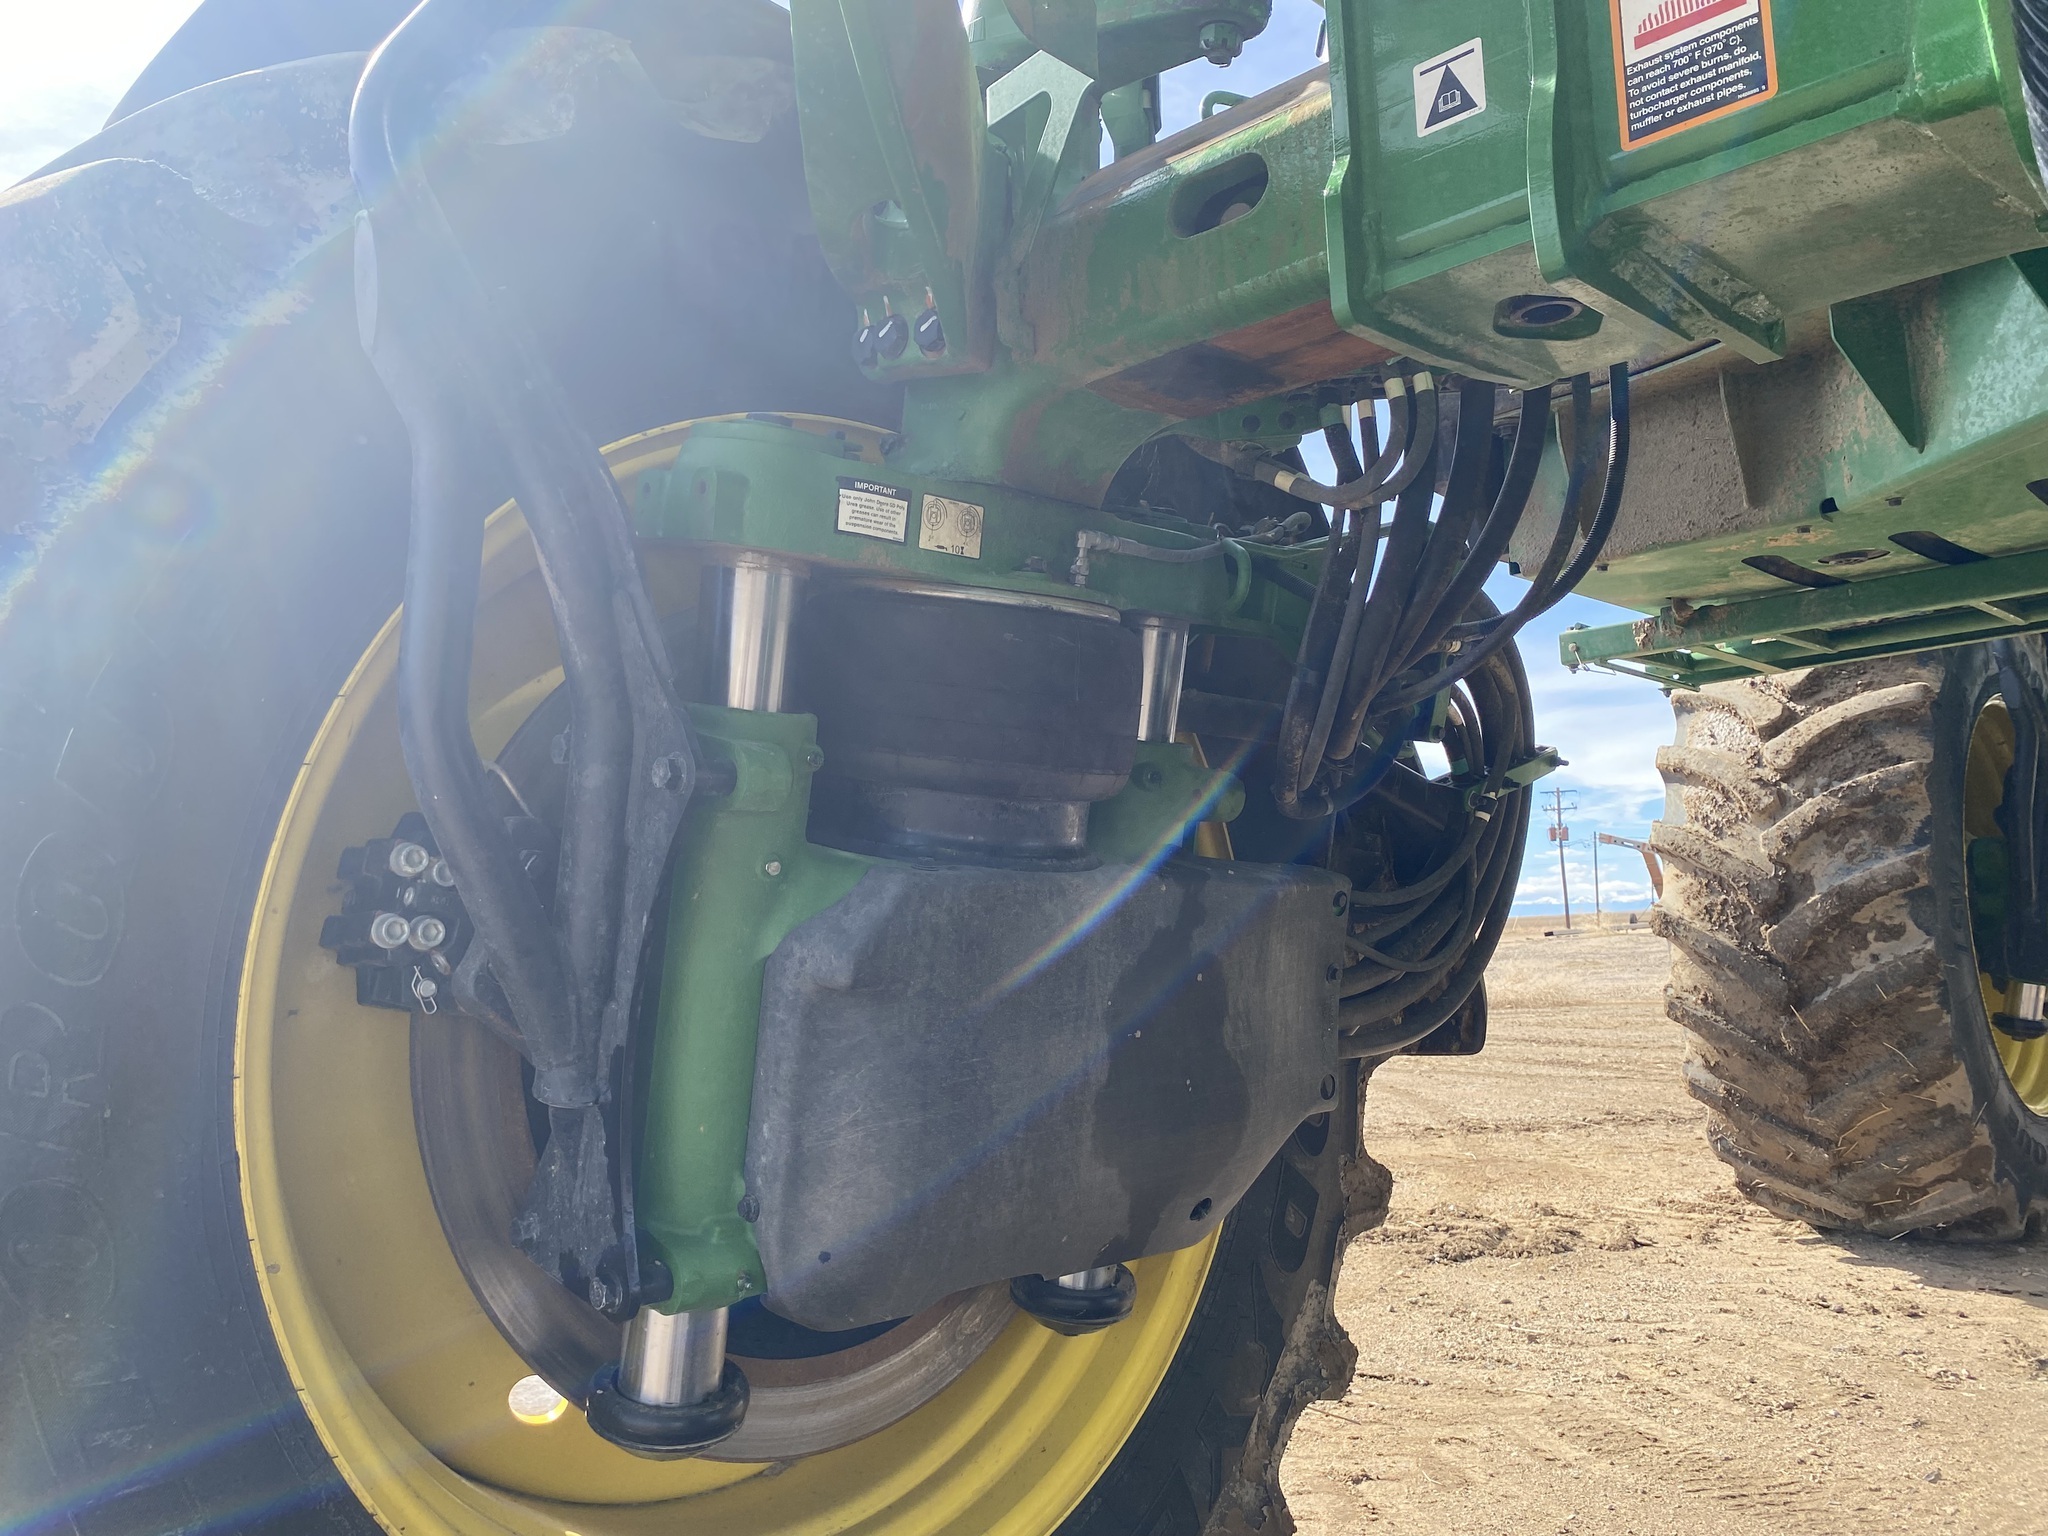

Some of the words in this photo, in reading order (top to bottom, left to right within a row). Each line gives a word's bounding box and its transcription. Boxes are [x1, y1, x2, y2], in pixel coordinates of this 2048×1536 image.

[1626, 55, 1663, 75] Exhaust
[1664, 41, 1698, 60] system
[1699, 16, 1759, 46] components
[1627, 75, 1644, 87] can
[1645, 64, 1671, 79] reach
[1695, 51, 1701, 60] F
[1628, 87, 1640, 98] To
[1641, 78, 1666, 92] avoid
[1668, 65, 1699, 81] severe
[1701, 53, 1732, 69] burns,
[1733, 45, 1747, 56] do
[1629, 97, 1644, 109] not
[1645, 85, 1679, 103] contact
[1680, 68, 1717, 89] exhaust
[1718, 51, 1762, 74] manifold,
[1629, 93, 1688, 120] turbocharger
[1690, 68, 1753, 97] components,
[1631, 114, 1663, 132] muffler
[1664, 109, 1675, 119] or
[1676, 94, 1715, 114] exhaust
[1716, 83, 1746, 104] pipes.
[854, 481, 897, 496] IMPORTANT
[845, 521, 872, 530] suspension
[849, 515, 872, 524] premature
